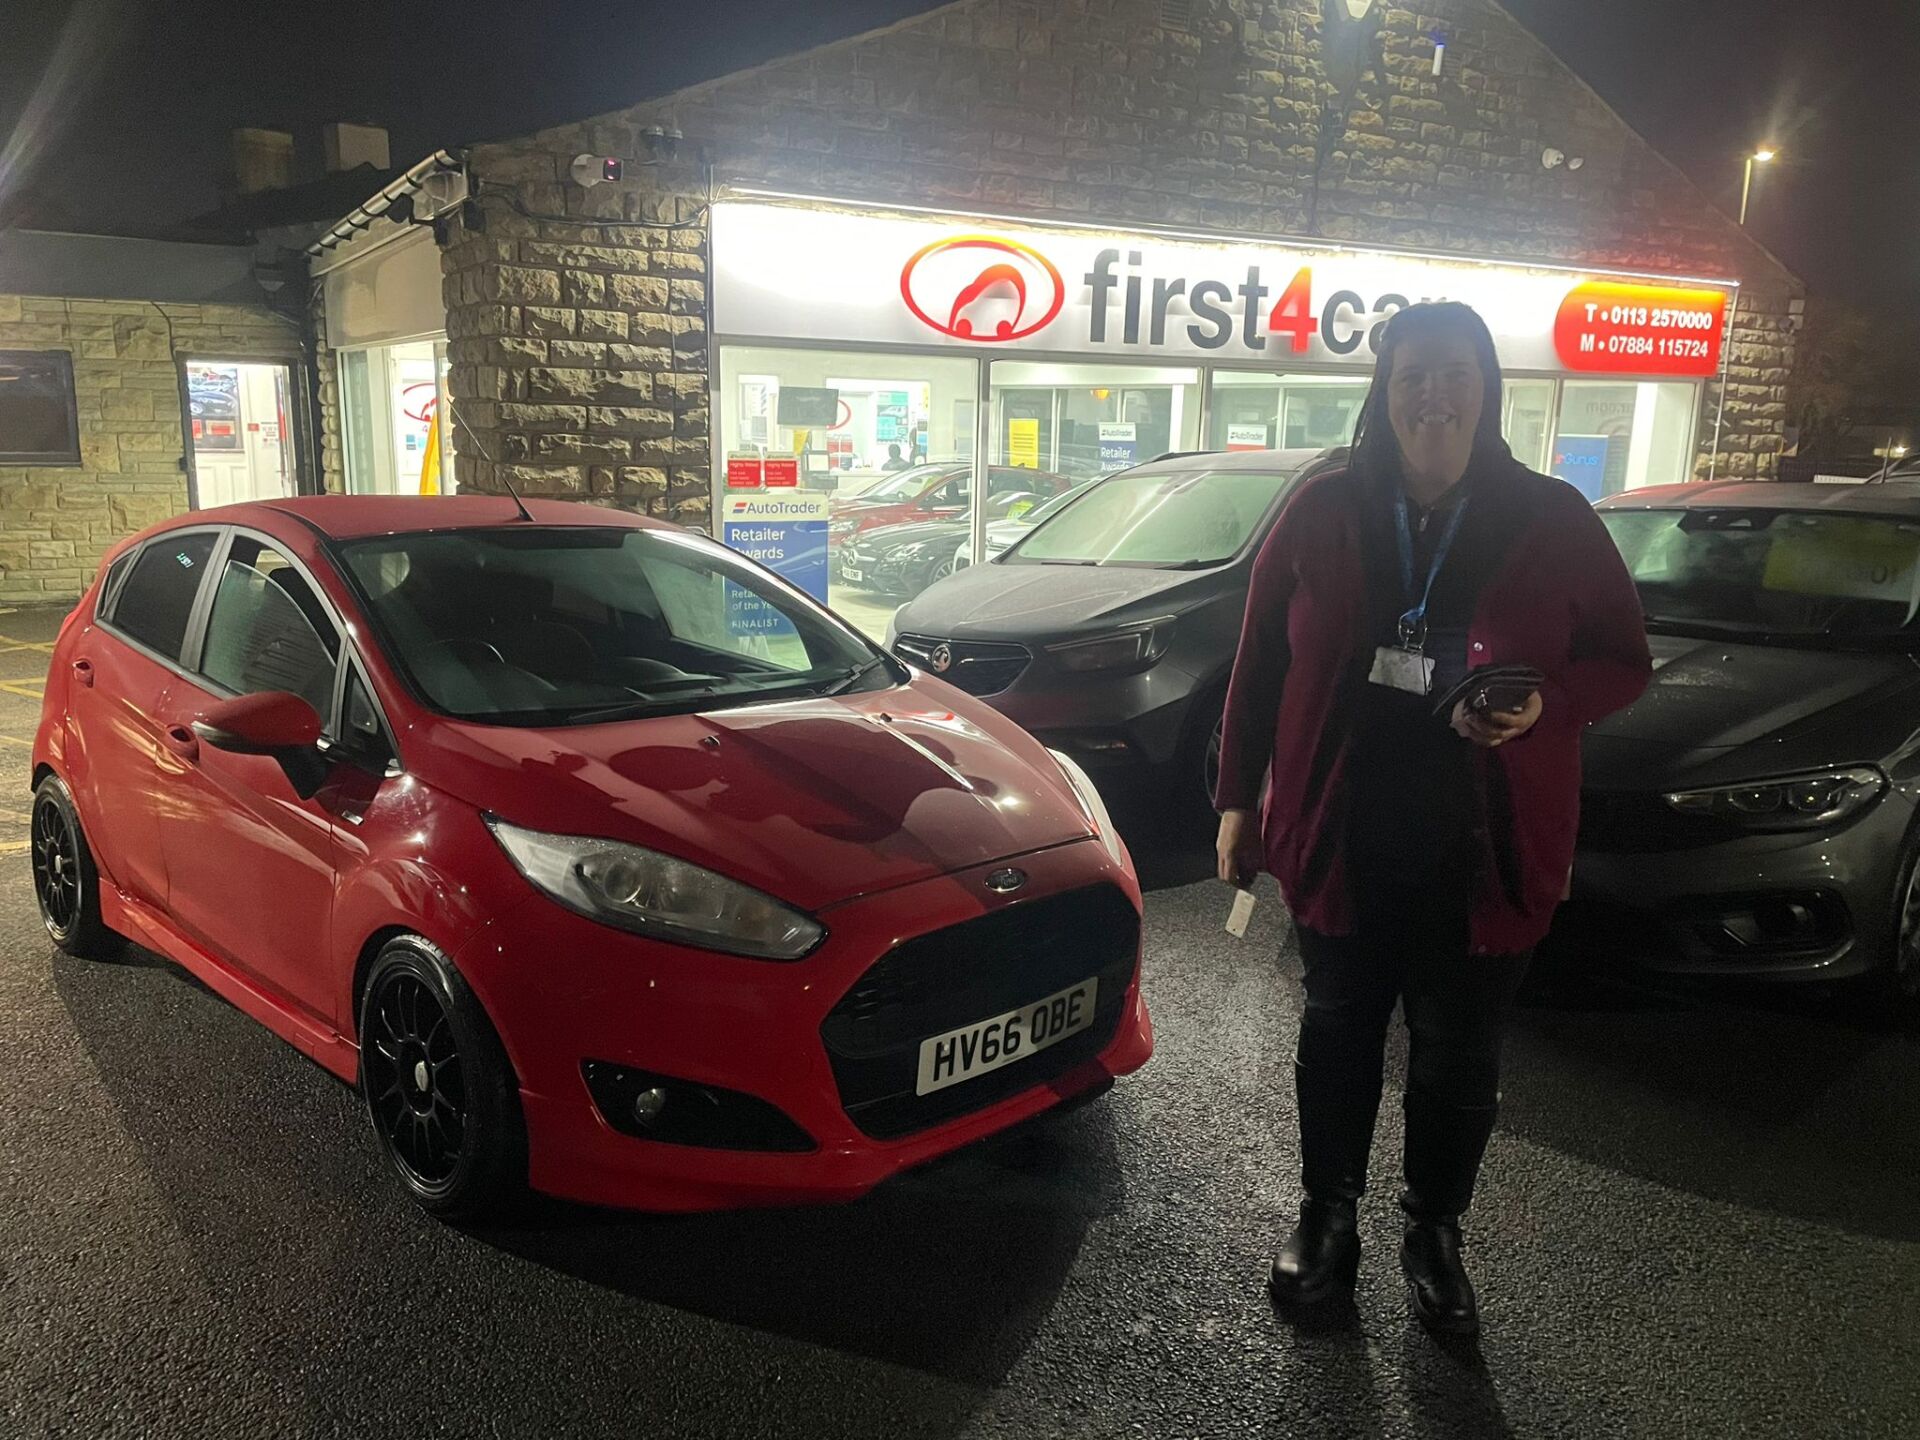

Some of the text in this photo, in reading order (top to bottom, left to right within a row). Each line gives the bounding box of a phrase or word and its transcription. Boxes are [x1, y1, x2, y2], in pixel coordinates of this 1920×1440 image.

[1084, 248, 1447, 355] first4ca
[1584, 303, 1713, 330] T 0113 2570000
[1580, 333, 1708, 357] M 07884 115724
[1101, 447, 1131, 460] Retailer
[747, 502, 821, 514] AutoTrader
[731, 529, 786, 541] Retailer
[732, 601, 774, 610] of the Ye
[731, 618, 779, 629] FINALIST
[933, 988, 1085, 1082] HV66 OBE
